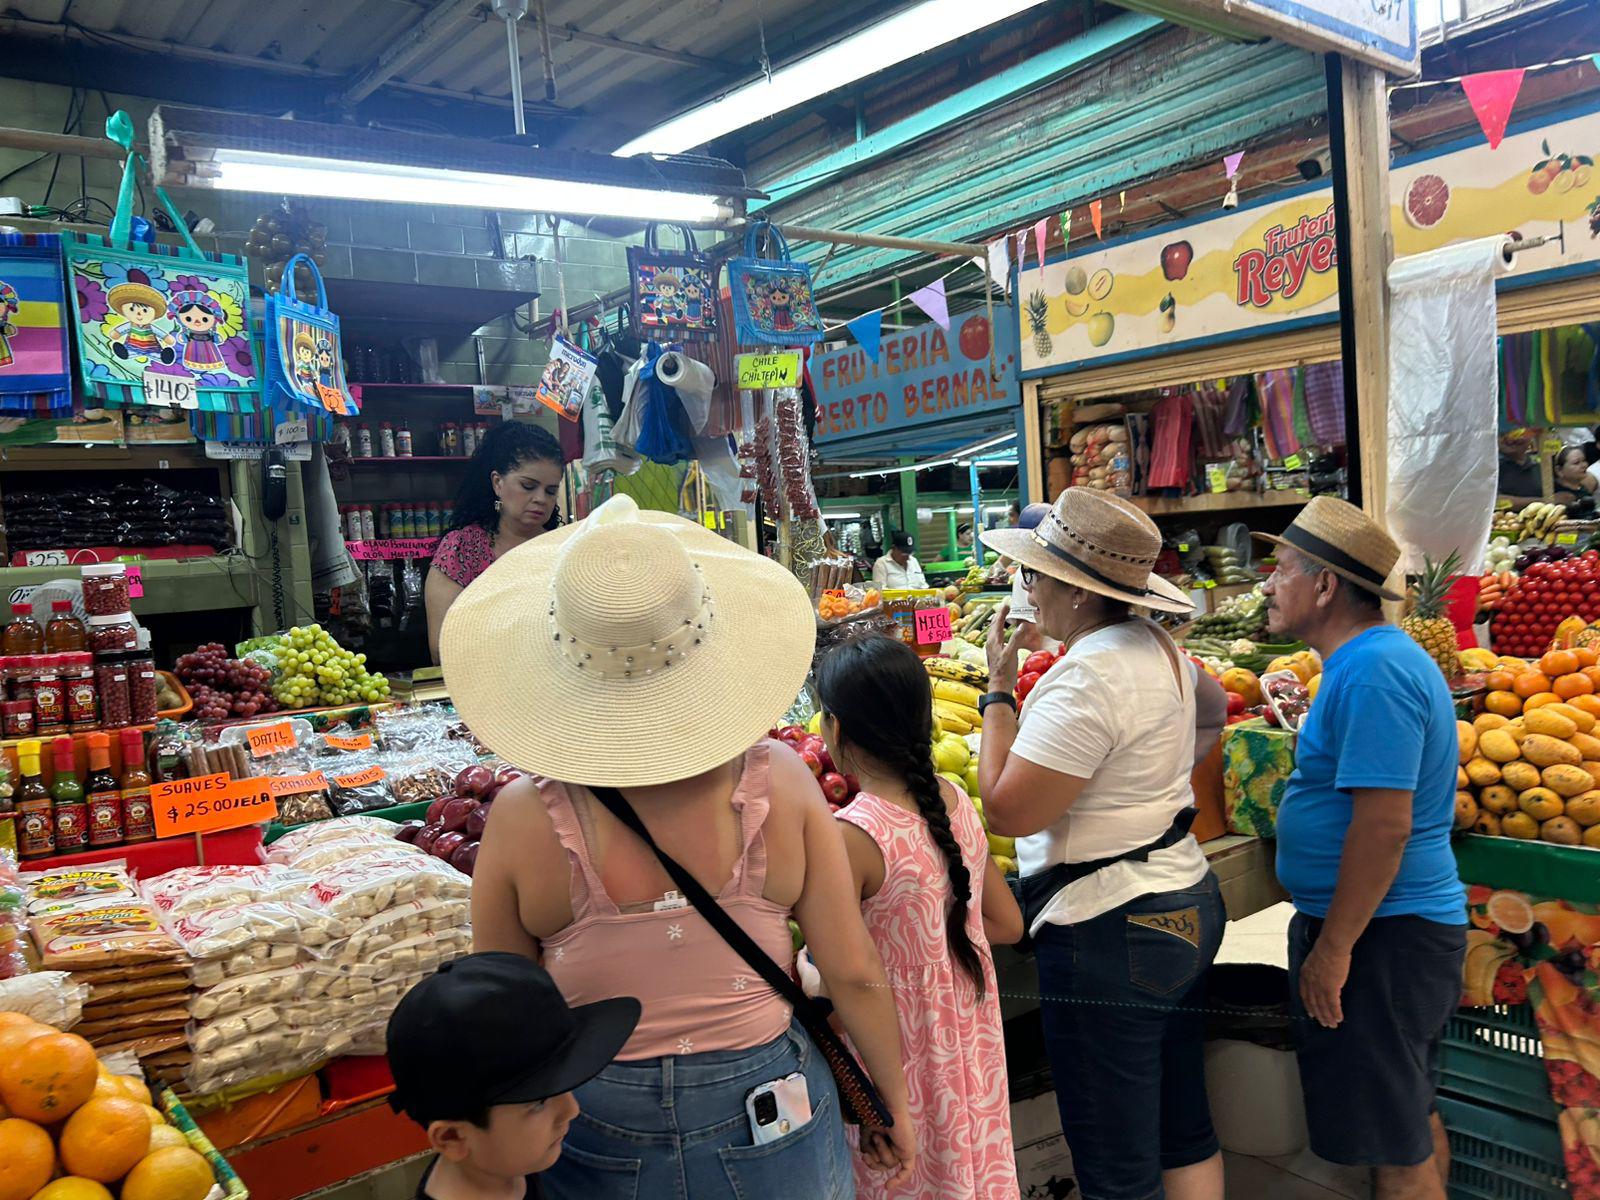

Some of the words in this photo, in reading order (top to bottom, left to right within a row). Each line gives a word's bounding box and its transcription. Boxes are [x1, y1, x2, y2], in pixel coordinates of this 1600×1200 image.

[1265, 203, 1336, 256] Fruteri
[752, 356, 779, 368] CHILE
[251, 731, 288, 747] DATIL
[158, 776, 227, 797] SUAVES
[270, 774, 327, 792] GRANOLA
